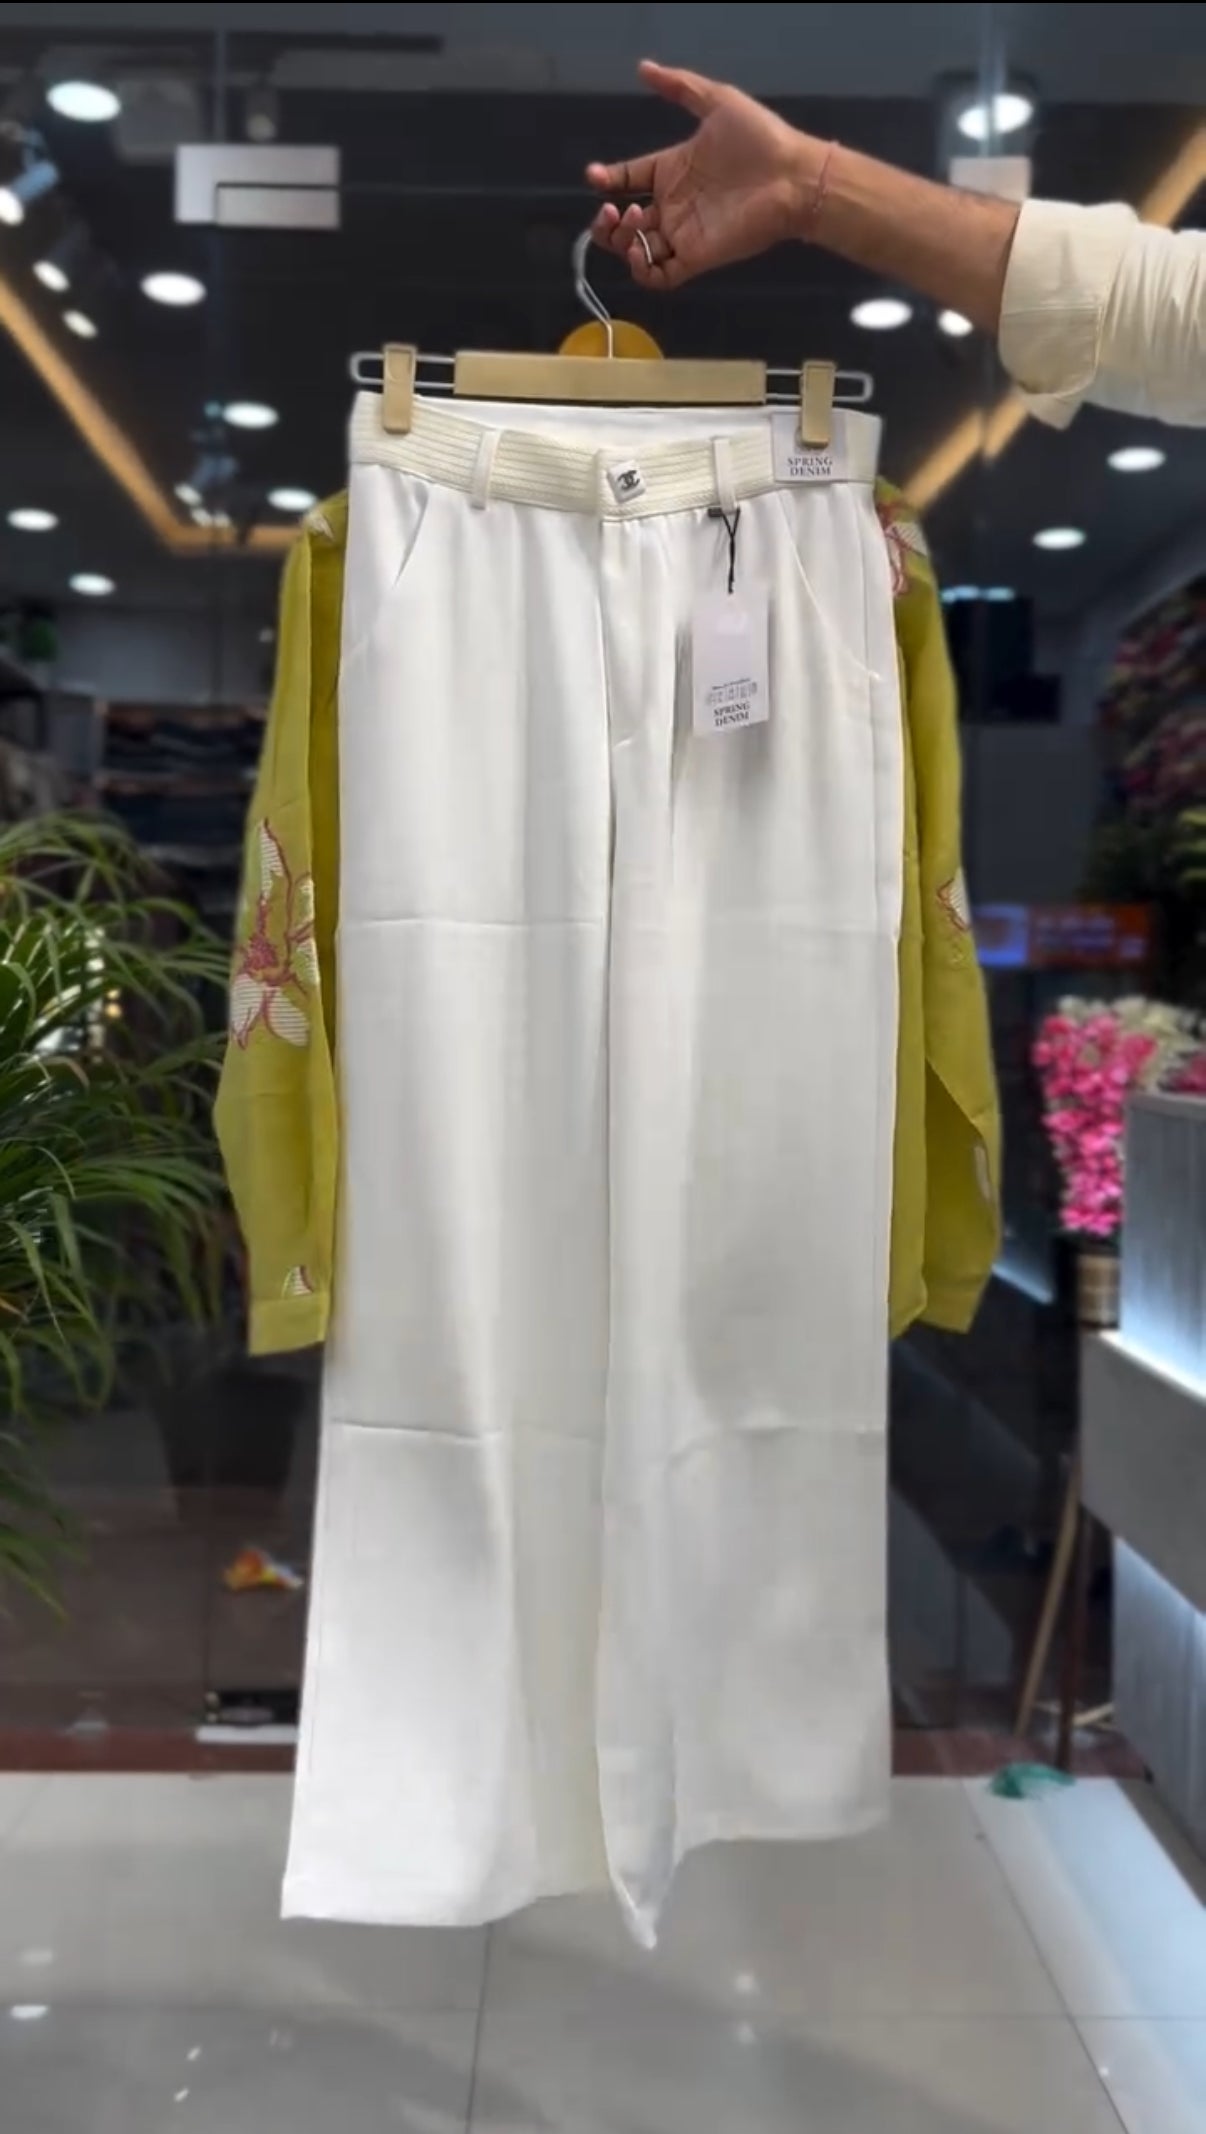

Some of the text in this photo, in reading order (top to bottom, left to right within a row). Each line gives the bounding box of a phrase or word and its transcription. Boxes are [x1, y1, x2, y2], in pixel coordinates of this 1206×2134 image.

[787, 457, 833, 466] SPRING
[790, 466, 831, 476] DENIM
[713, 702, 751, 716] SPRING
[714, 712, 749, 726] DENIM
